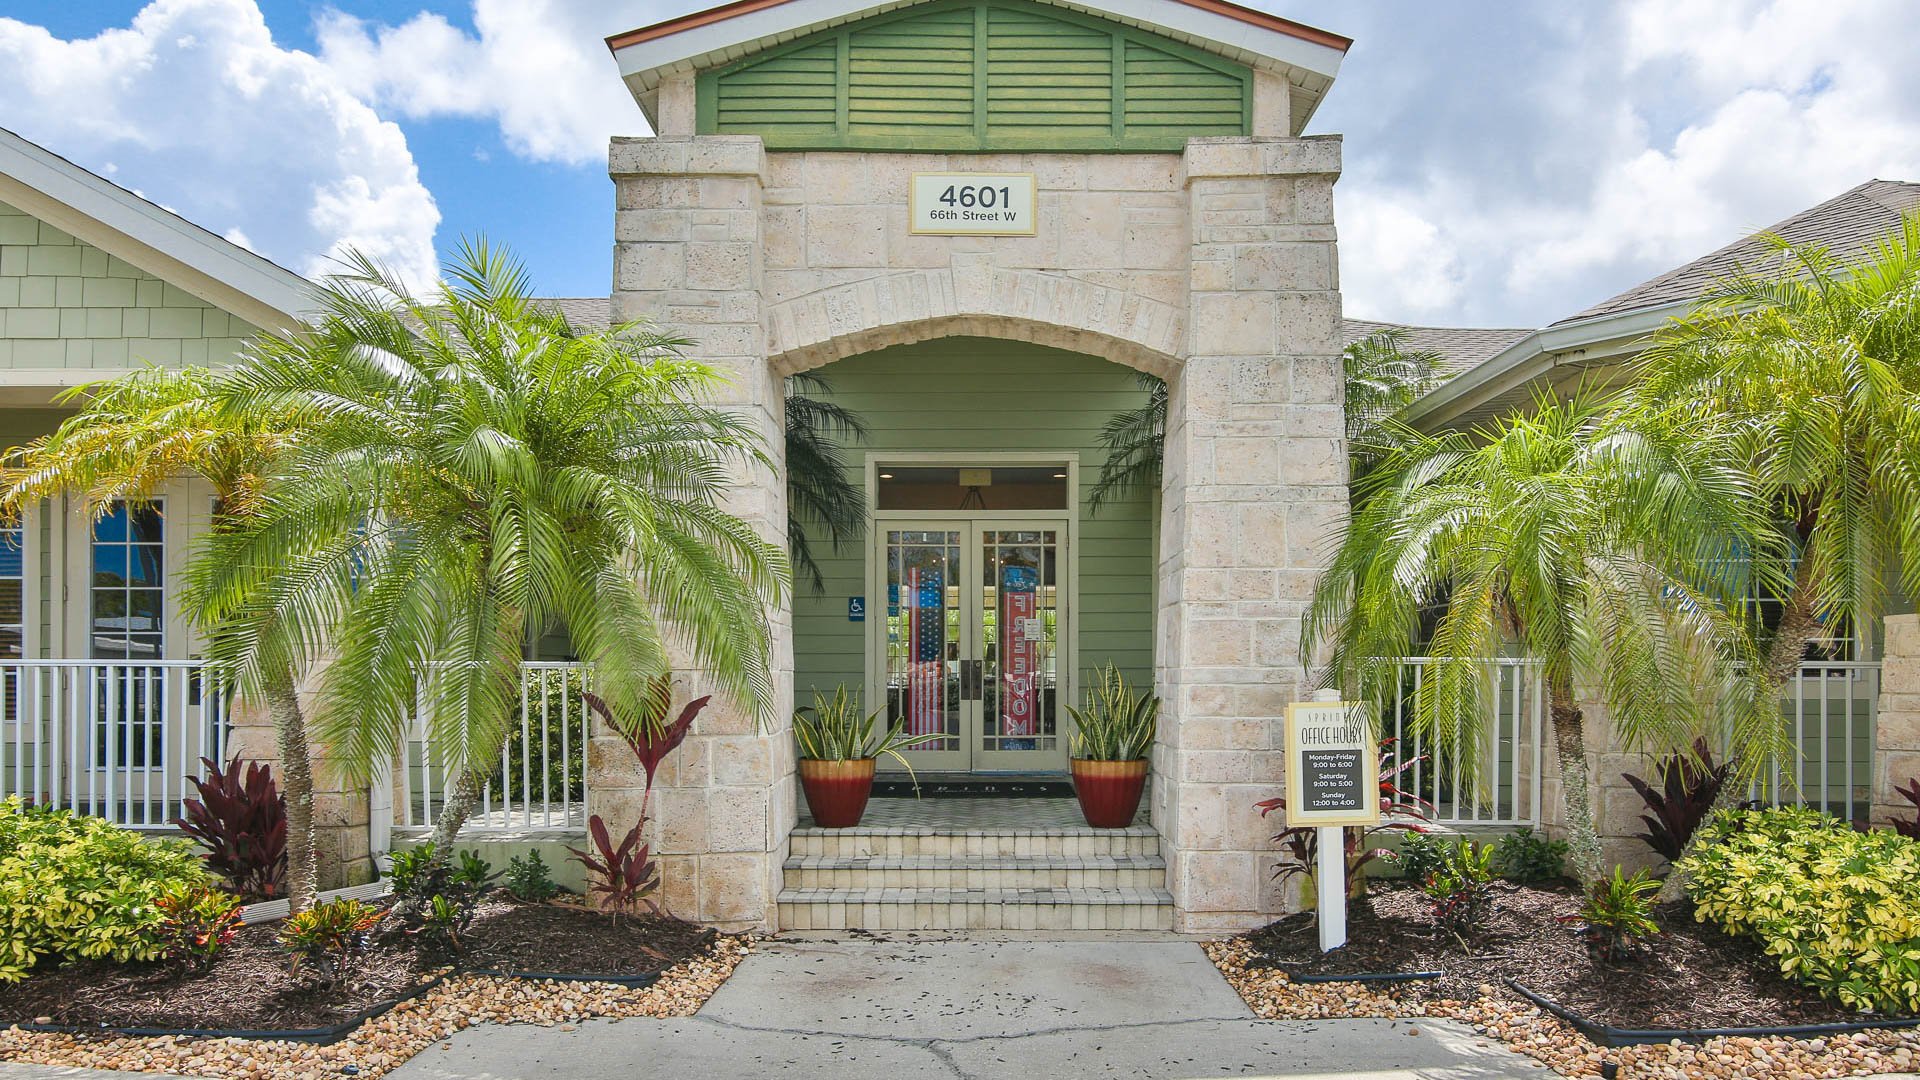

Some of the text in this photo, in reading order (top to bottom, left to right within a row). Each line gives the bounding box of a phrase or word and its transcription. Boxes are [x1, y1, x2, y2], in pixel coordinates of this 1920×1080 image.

[939, 185, 1009, 209] 4601
[930, 209, 1017, 222] 66th Street W
[1301, 726, 1362, 745] OFFICE HOURS
